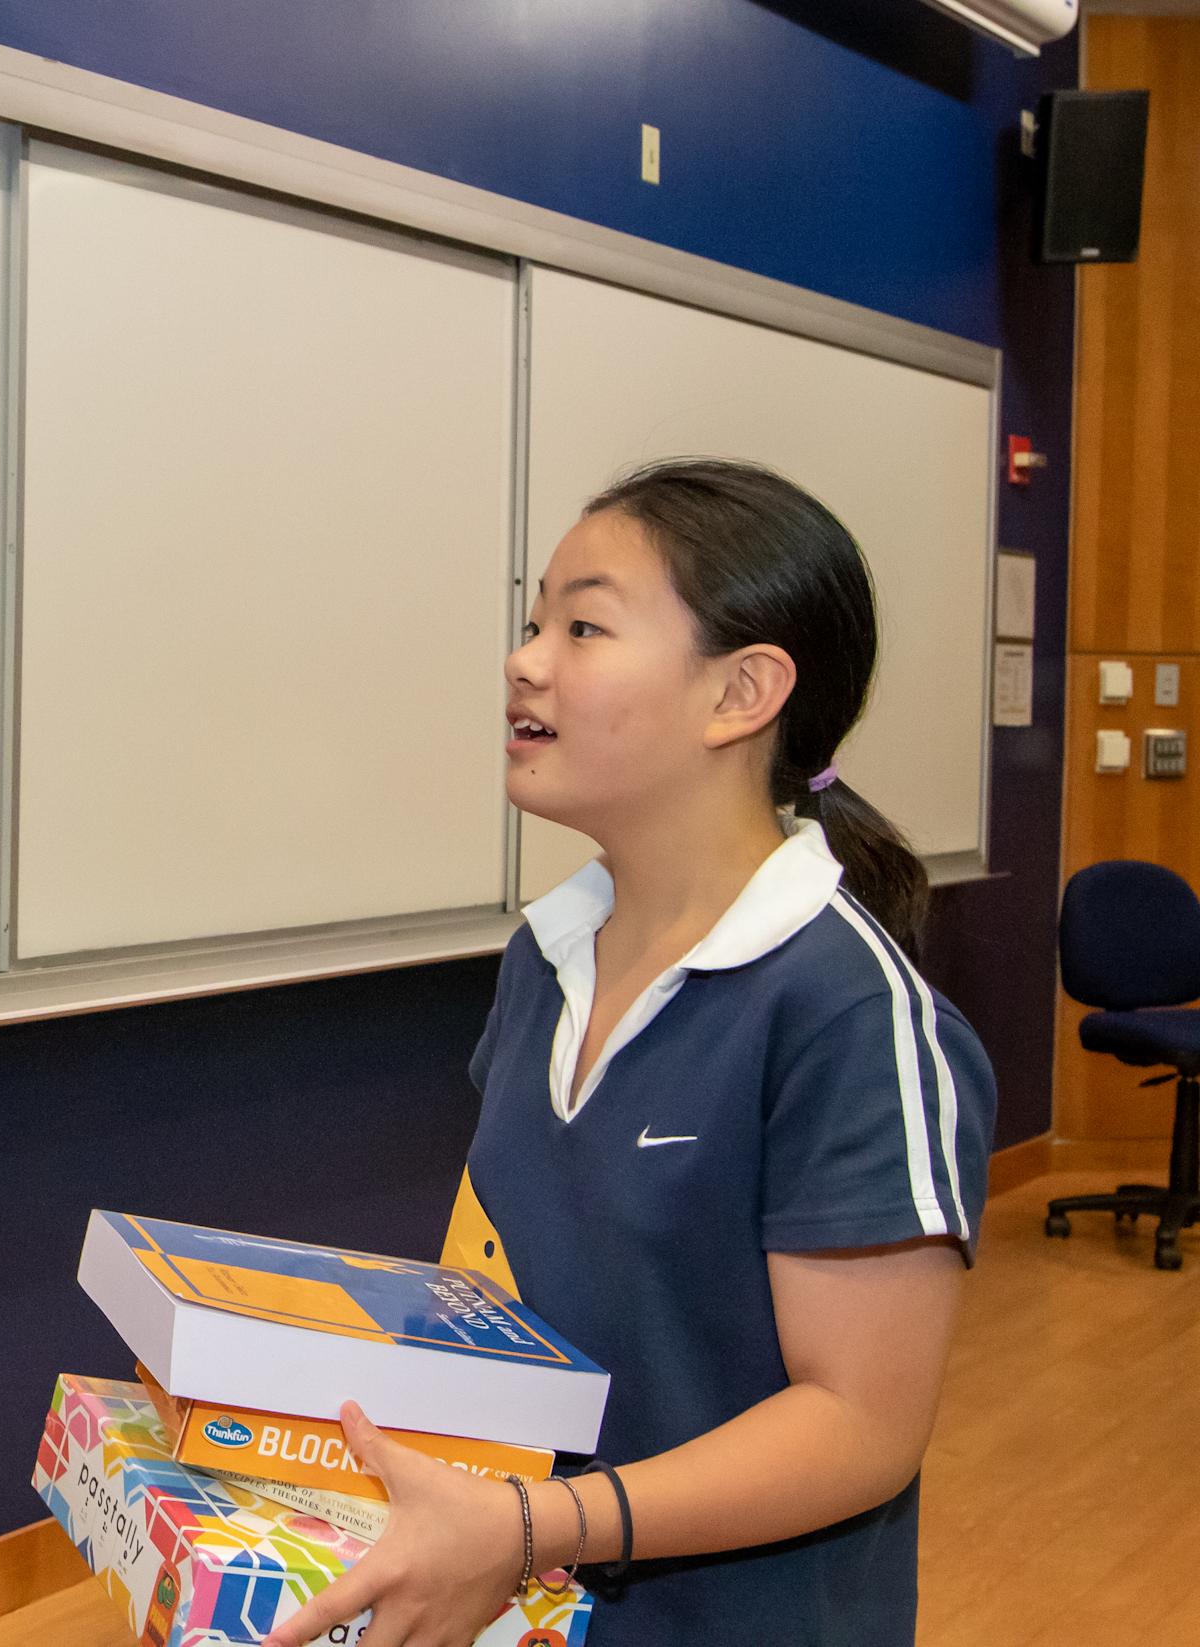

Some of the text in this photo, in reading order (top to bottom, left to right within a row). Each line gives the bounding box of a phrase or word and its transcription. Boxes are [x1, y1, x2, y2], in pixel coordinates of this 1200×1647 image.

[424, 1282, 490, 1330] BEYOND
[78, 1462, 144, 1565] passtally
[325, 1508, 333, 1517] &
[336, 1511, 373, 1531] THINGS
